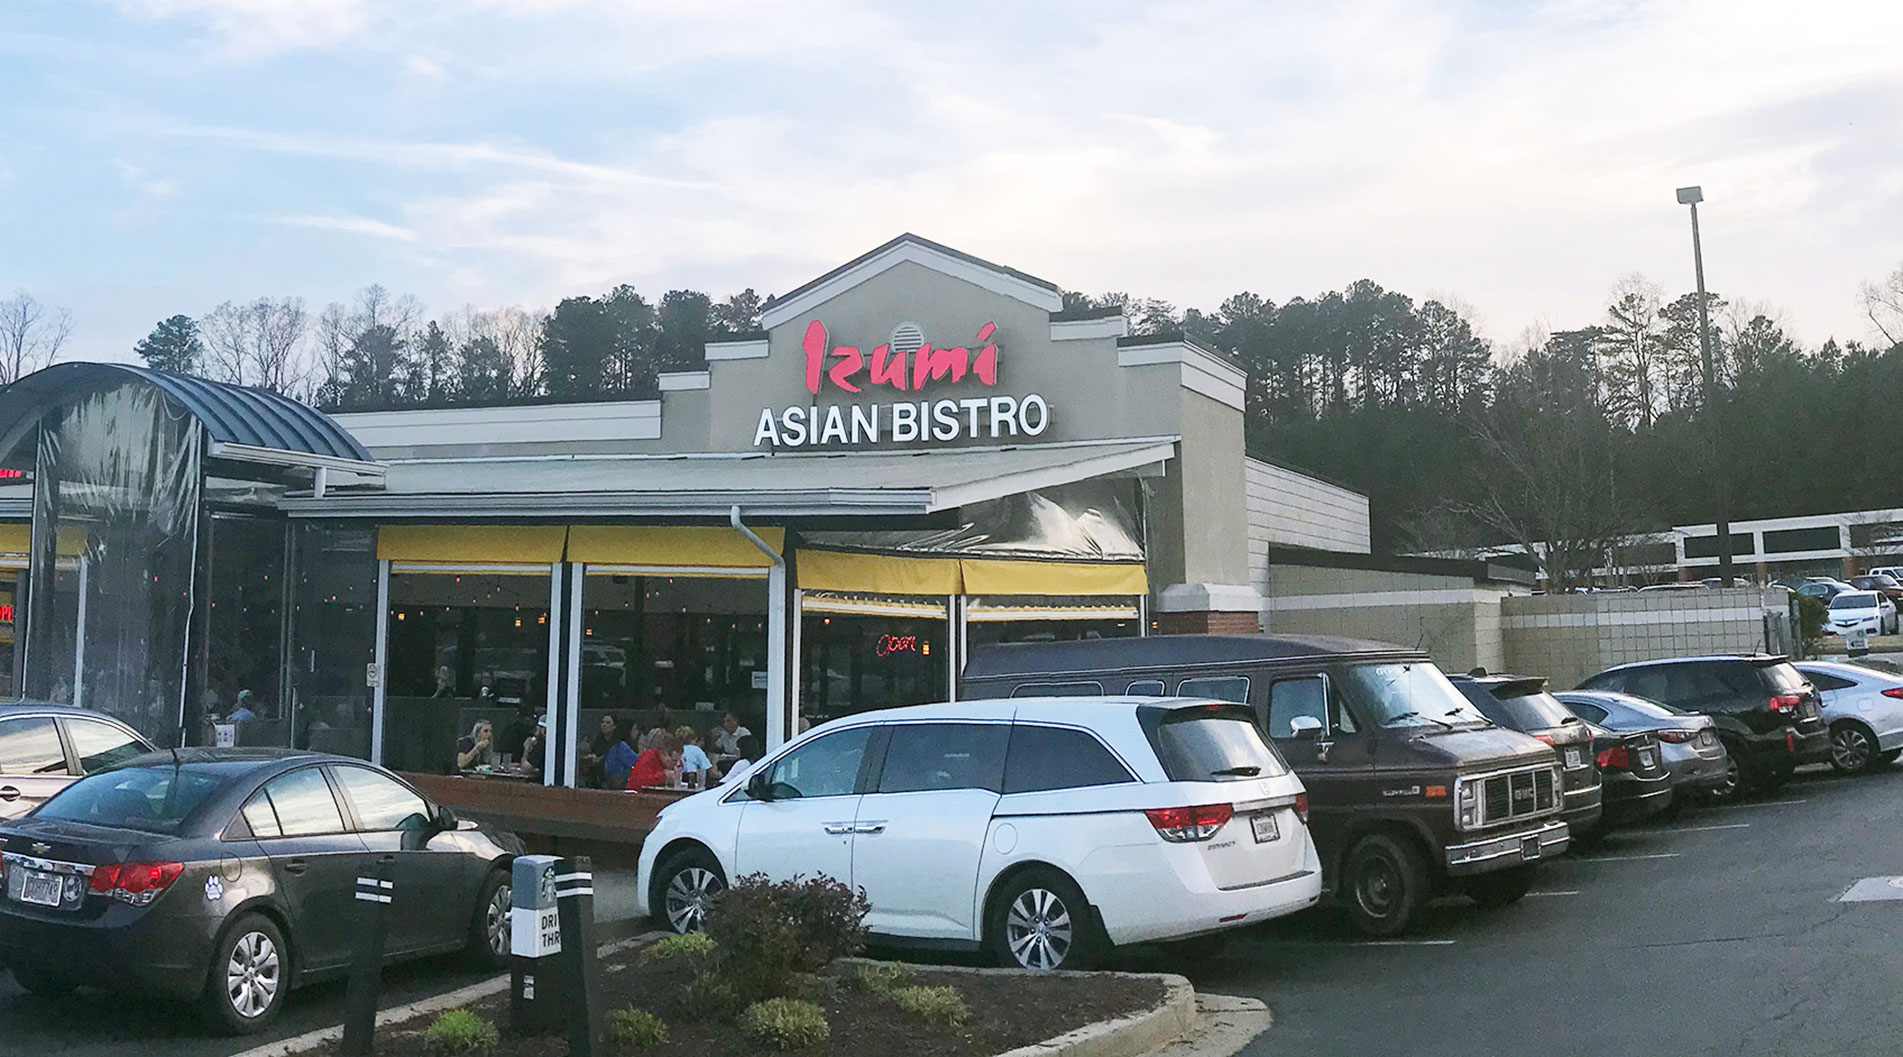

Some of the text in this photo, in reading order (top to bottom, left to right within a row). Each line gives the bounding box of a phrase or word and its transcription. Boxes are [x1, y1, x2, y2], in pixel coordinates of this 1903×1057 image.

[803, 320, 997, 394] Izumi
[753, 394, 1048, 446] ASIAN BISTRO
[541, 915, 557, 930] DRI
[541, 931, 560, 947] THR
